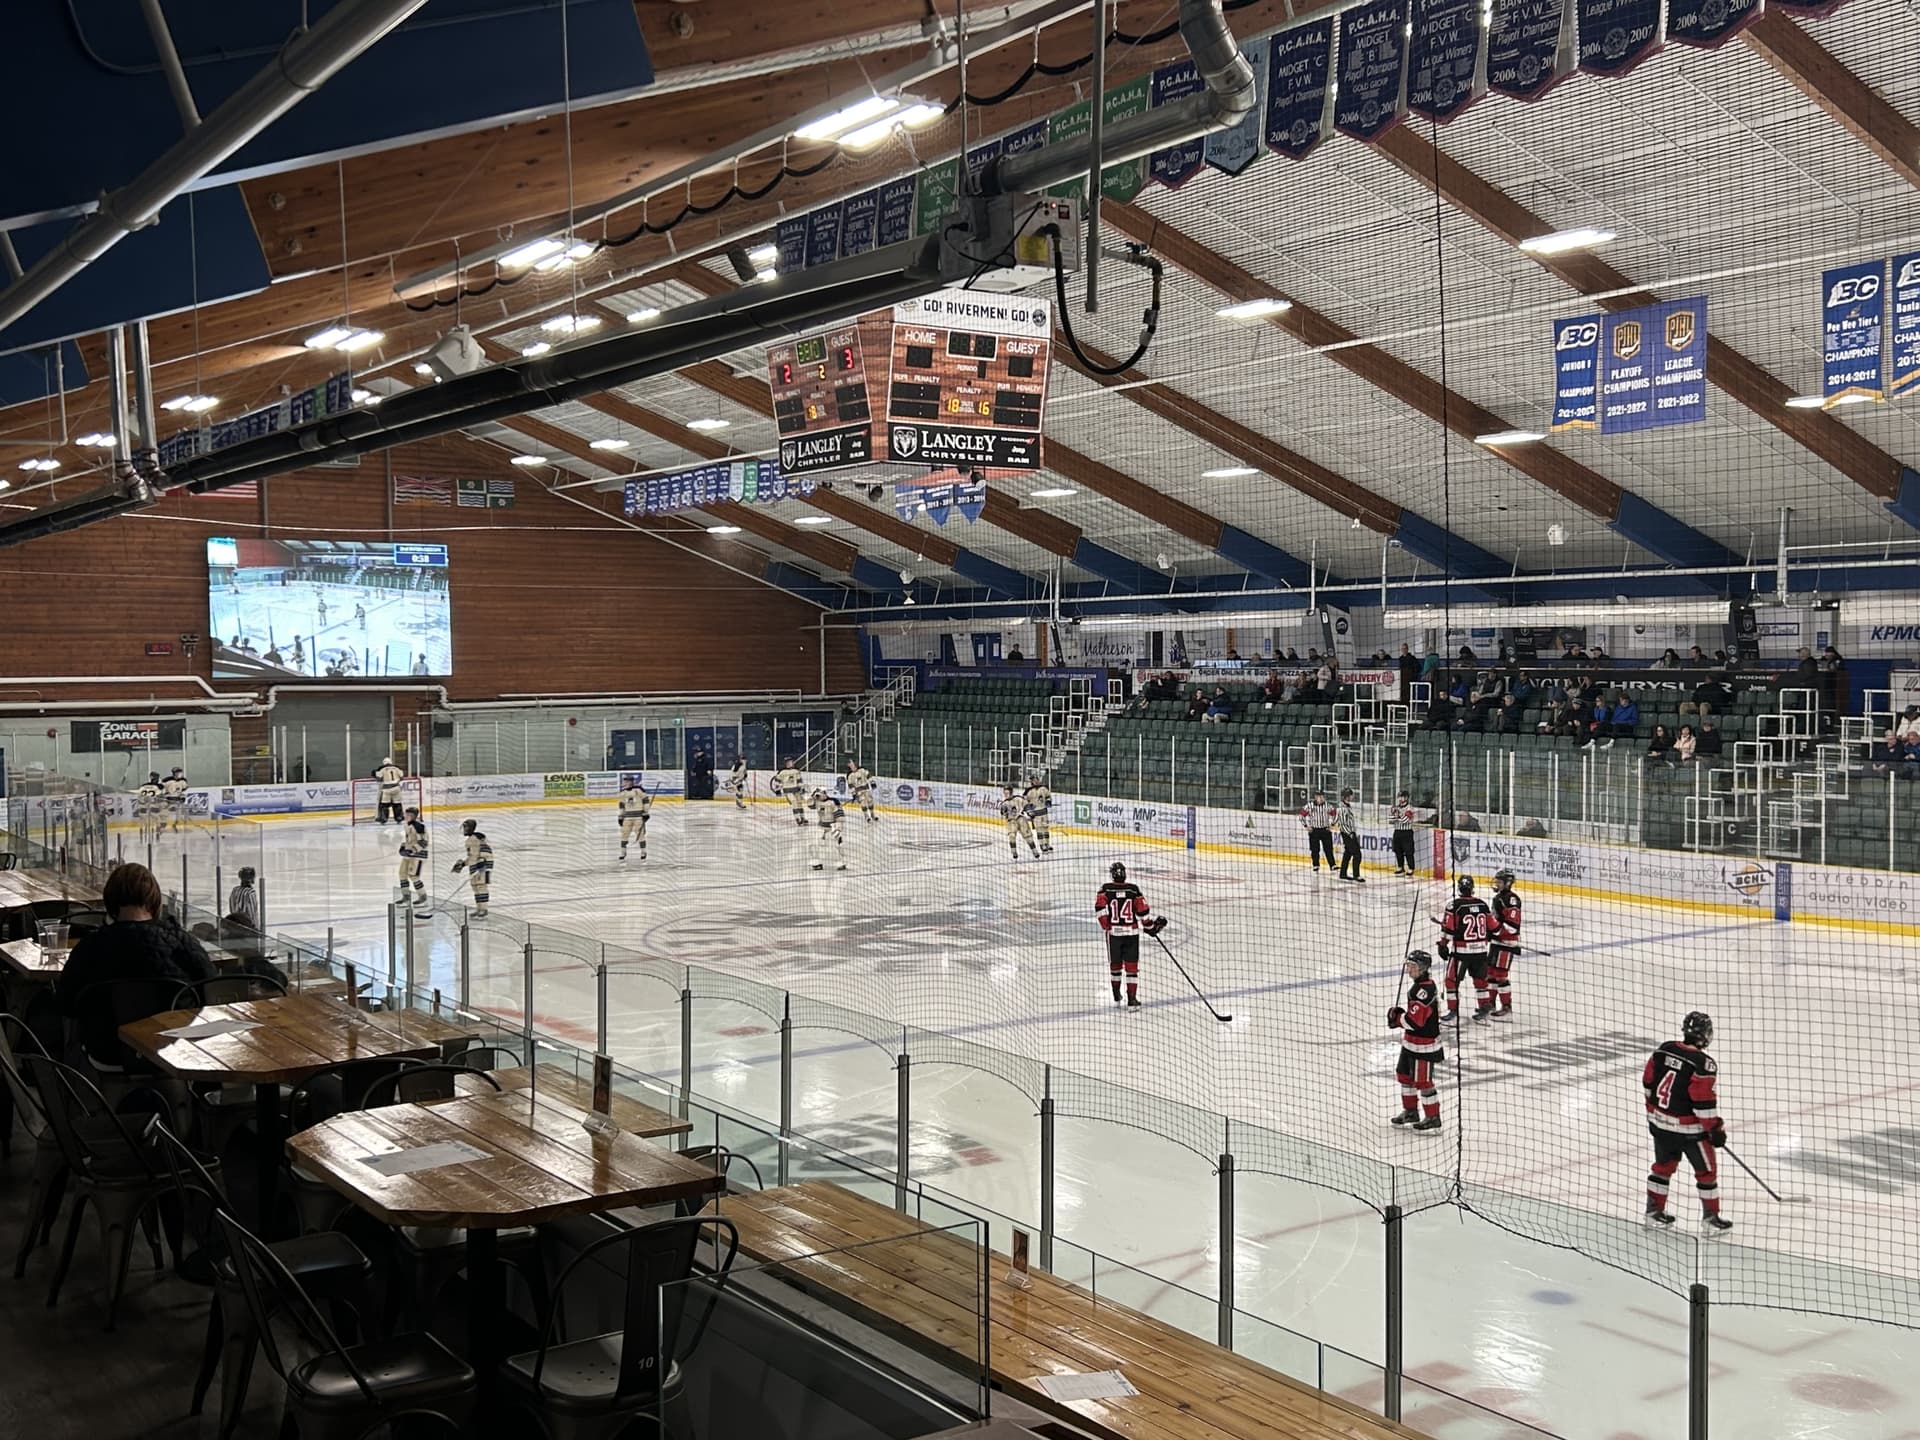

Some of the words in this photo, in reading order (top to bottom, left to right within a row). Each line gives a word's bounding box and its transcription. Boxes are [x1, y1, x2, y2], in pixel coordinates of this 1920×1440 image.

[1348, 9, 1400, 34] P.C.A.H.A.
[1675, 10, 1697, 31] 2006
[1278, 31, 1327, 56] P.C.A.H.A.
[1356, 31, 1390, 49] MIDGET
[1581, 41, 1600, 59] 2006
[1630, 25, 1653, 43] 2007
[1278, 58, 1308, 78] MIDGET
[1493, 68, 1517, 82] 2006
[1160, 70, 1200, 91] P.C.A.H.A.
[1105, 88, 1145, 112] P.C.A.H.A.
[1339, 111, 1359, 124] 2006
[1270, 128, 1289, 142] 2006
[924, 299, 943, 313] GO!
[946, 301, 1008, 320] RIVERMEN!
[1011, 309, 1029, 323] GO!
[1827, 323, 1840, 333] Pee
[1858, 317, 1872, 328] Tier
[831, 334, 854, 348] GUEST
[904, 330, 937, 344] HOME
[1006, 341, 1041, 355] GUEST
[1825, 346, 1879, 363] CHAMPIONS
[772, 349, 790, 362] HOME
[844, 348, 854, 370] 3
[1561, 361, 1586, 372] JUNIOR
[1664, 357, 1693, 371] LEAGUE
[783, 364, 792, 384] 2
[818, 363, 826, 380] 2
[914, 373, 940, 383] PENALTY
[1611, 366, 1642, 380] PLAYOFF
[1655, 369, 1703, 386] CHAMPIONS
[956, 386, 981, 395] PENALTY
[1604, 378, 1650, 394] CHAMPIONS
[948, 398, 960, 413] 18
[1657, 393, 1700, 409] 2021-2022
[978, 401, 990, 416] 16
[1607, 402, 1647, 417] 2021-2022
[798, 434, 843, 458] LANGLEY
[921, 431, 996, 452] LANGLEY
[798, 454, 841, 467] CHRYSLER
[921, 451, 993, 462] CHRYSLER
[1344, 672, 1382, 684] DELIVERY
[100, 722, 137, 732] ZONE
[102, 731, 159, 740] GARAGE
[967, 793, 981, 808] Tim
[1076, 804, 1090, 819] TD
[1098, 802, 1124, 814] Ready
[1133, 808, 1156, 820] MNP
[1098, 816, 1109, 827] for
[1111, 820, 1125, 829] you
[1728, 824, 1736, 834] C
[1475, 839, 1536, 859] LANGLEY
[1549, 847, 1579, 856] PROUDLY
[1542, 861, 1554, 869] THE
[1557, 863, 1586, 873] LANGLEY
[1548, 855, 1580, 865] SUPPORT
[1546, 871, 1581, 880] RIVERMEN
[1735, 873, 1767, 886] BCHL
[1110, 899, 1133, 923] 14
[1656, 1070, 1676, 1109] 4
[638, 1357, 654, 1369] 10
